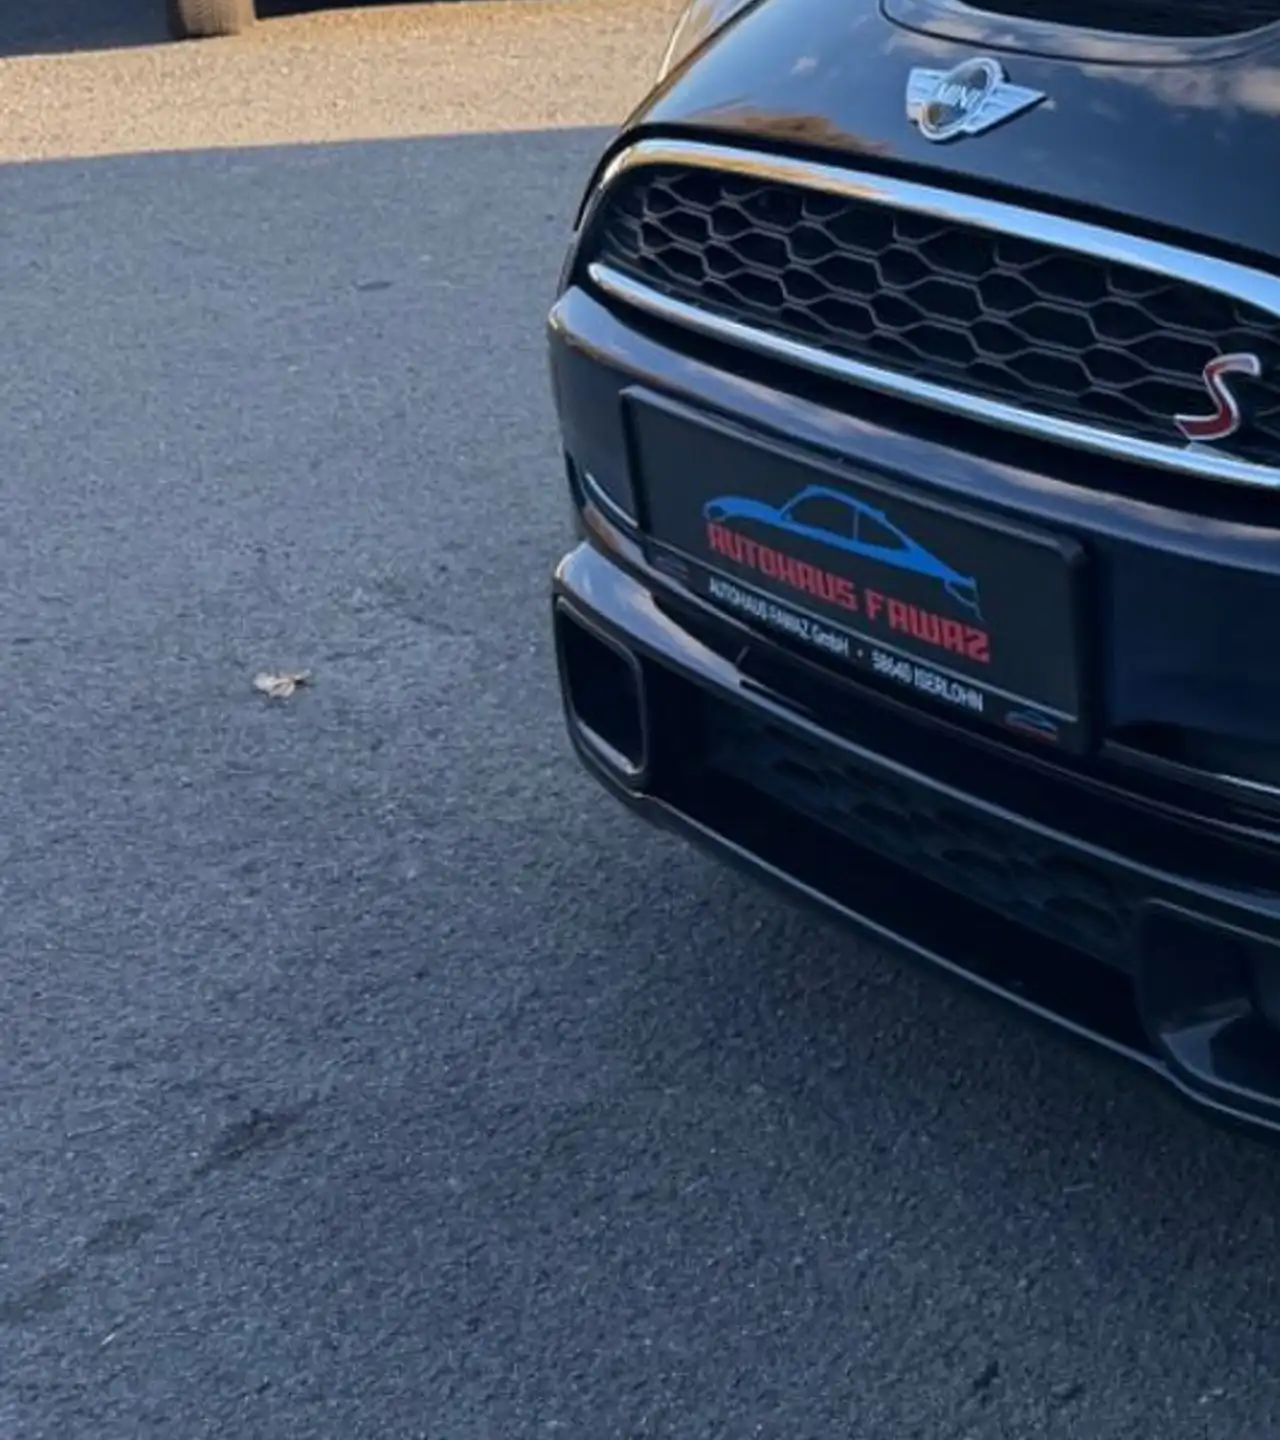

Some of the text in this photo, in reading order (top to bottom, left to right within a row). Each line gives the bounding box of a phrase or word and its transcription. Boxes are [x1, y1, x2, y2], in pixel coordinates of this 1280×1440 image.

[707, 521, 990, 663] AUTOHAUS FAWAZ
[914, 665, 984, 713] ISERLOHN
